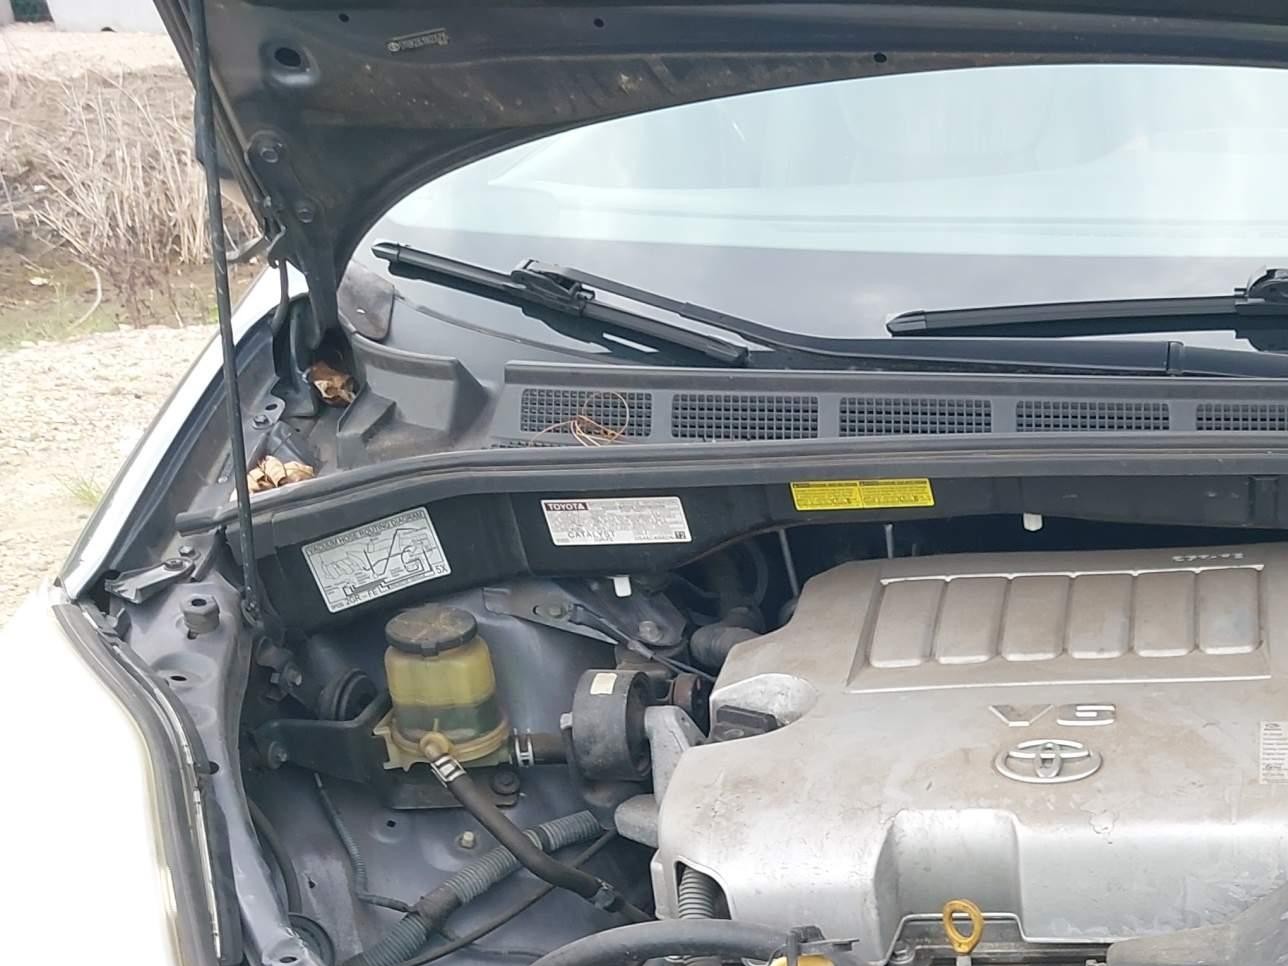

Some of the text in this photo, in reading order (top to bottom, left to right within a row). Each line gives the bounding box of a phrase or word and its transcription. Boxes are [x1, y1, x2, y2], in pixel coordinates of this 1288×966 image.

[548, 503, 586, 511] TOYOTA
[358, 520, 391, 538] ROUTING
[390, 510, 424, 528] DIAGRAM
[568, 530, 616, 539] CATALYST
